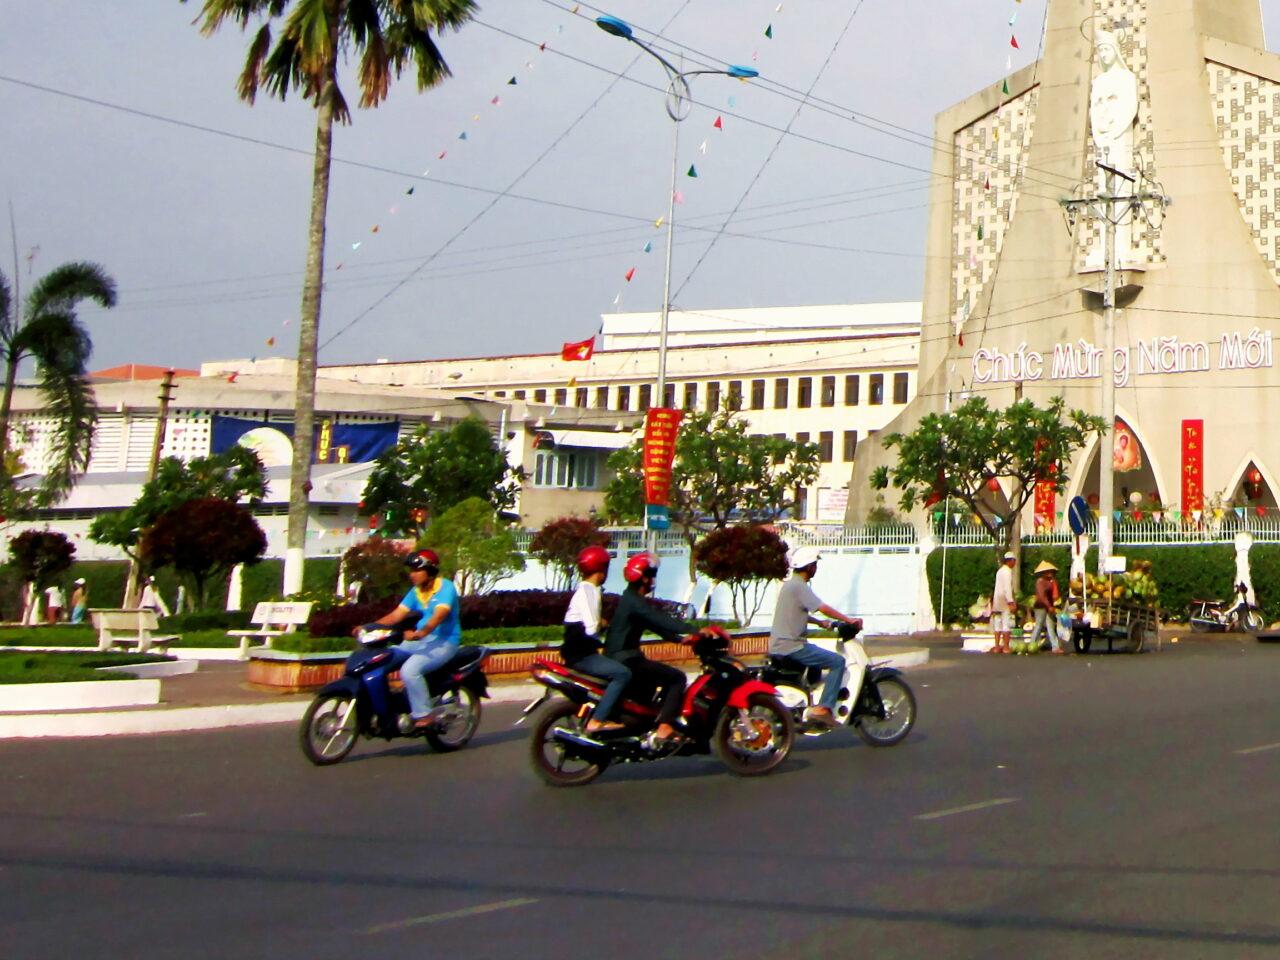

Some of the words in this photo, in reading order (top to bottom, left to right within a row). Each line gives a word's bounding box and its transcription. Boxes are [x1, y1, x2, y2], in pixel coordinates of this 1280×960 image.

[972, 342, 1043, 383] Chúc
[1137, 335, 1210, 375] Năm
[1219, 326, 1273, 370] Mới
